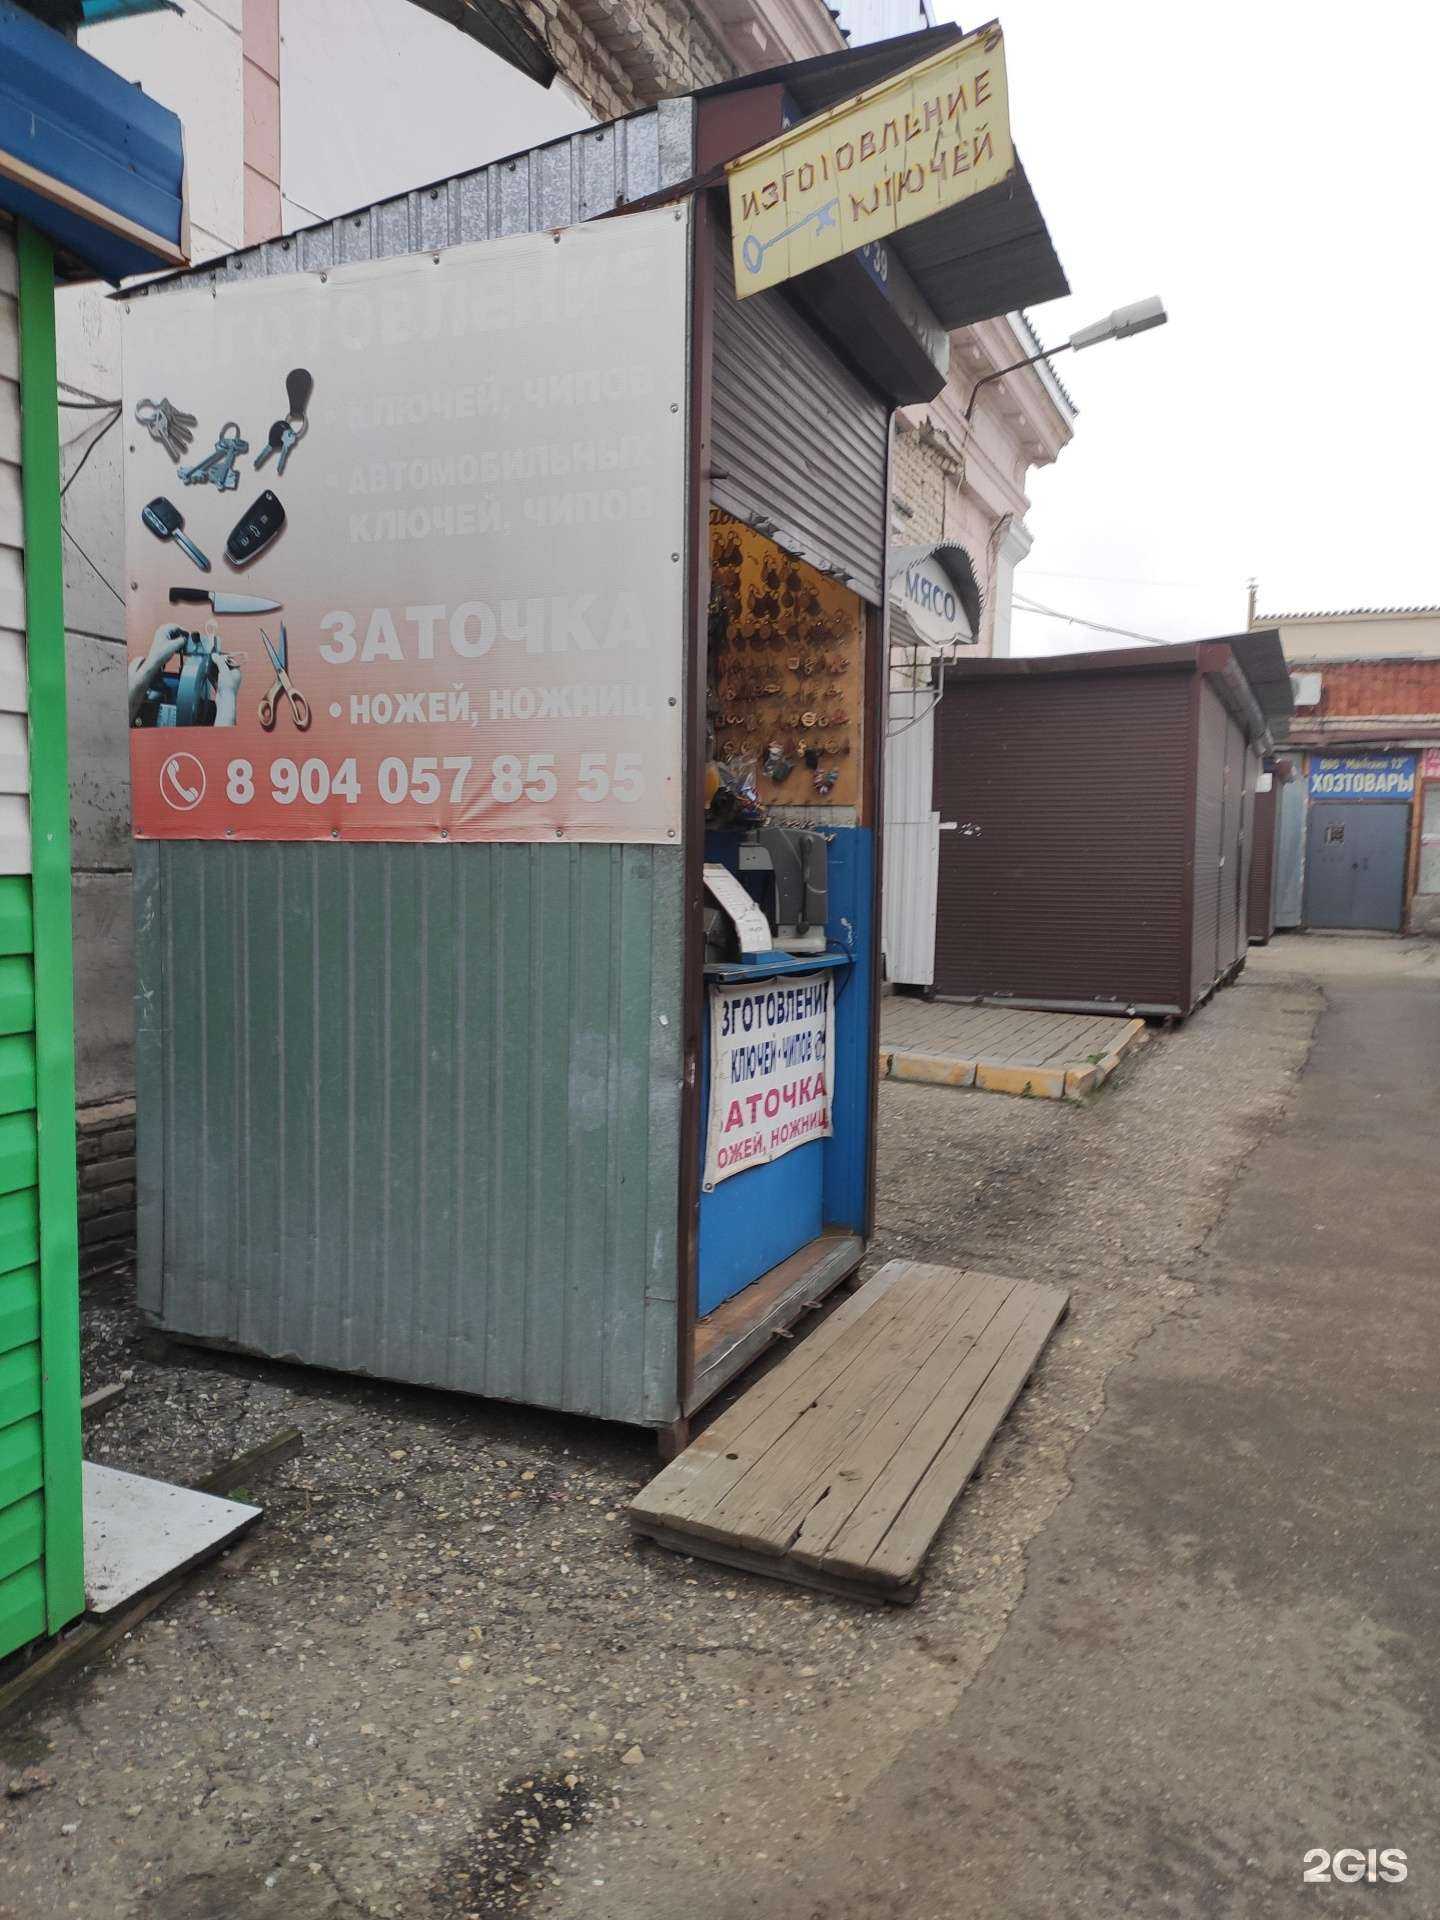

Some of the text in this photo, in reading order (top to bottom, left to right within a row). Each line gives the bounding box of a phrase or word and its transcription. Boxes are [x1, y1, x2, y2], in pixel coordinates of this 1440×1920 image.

[849, 122, 994, 222] КЛЮЧЕЙ
[523, 364, 655, 409] ЧИПОВ
[347, 432, 657, 495] АВТОМОБИЛЬНЫХ
[348, 492, 511, 543] КЛЮЧЕЙ,
[523, 486, 655, 528] ЧИПОВ
[905, 569, 955, 622] МЯСО
[319, 590, 651, 664] ЗАТОЧКА
[350, 683, 652, 727] НОЖЕЙ, НОЖНИЦ
[226, 753, 646, 805] 8 904 057 85 55
[1311, 773, 1414, 793] ХОЗТОВАРЫ
[720, 1072, 828, 1133] АТОЧКА
[770, 1107, 829, 1149] НОЖНИЦ
